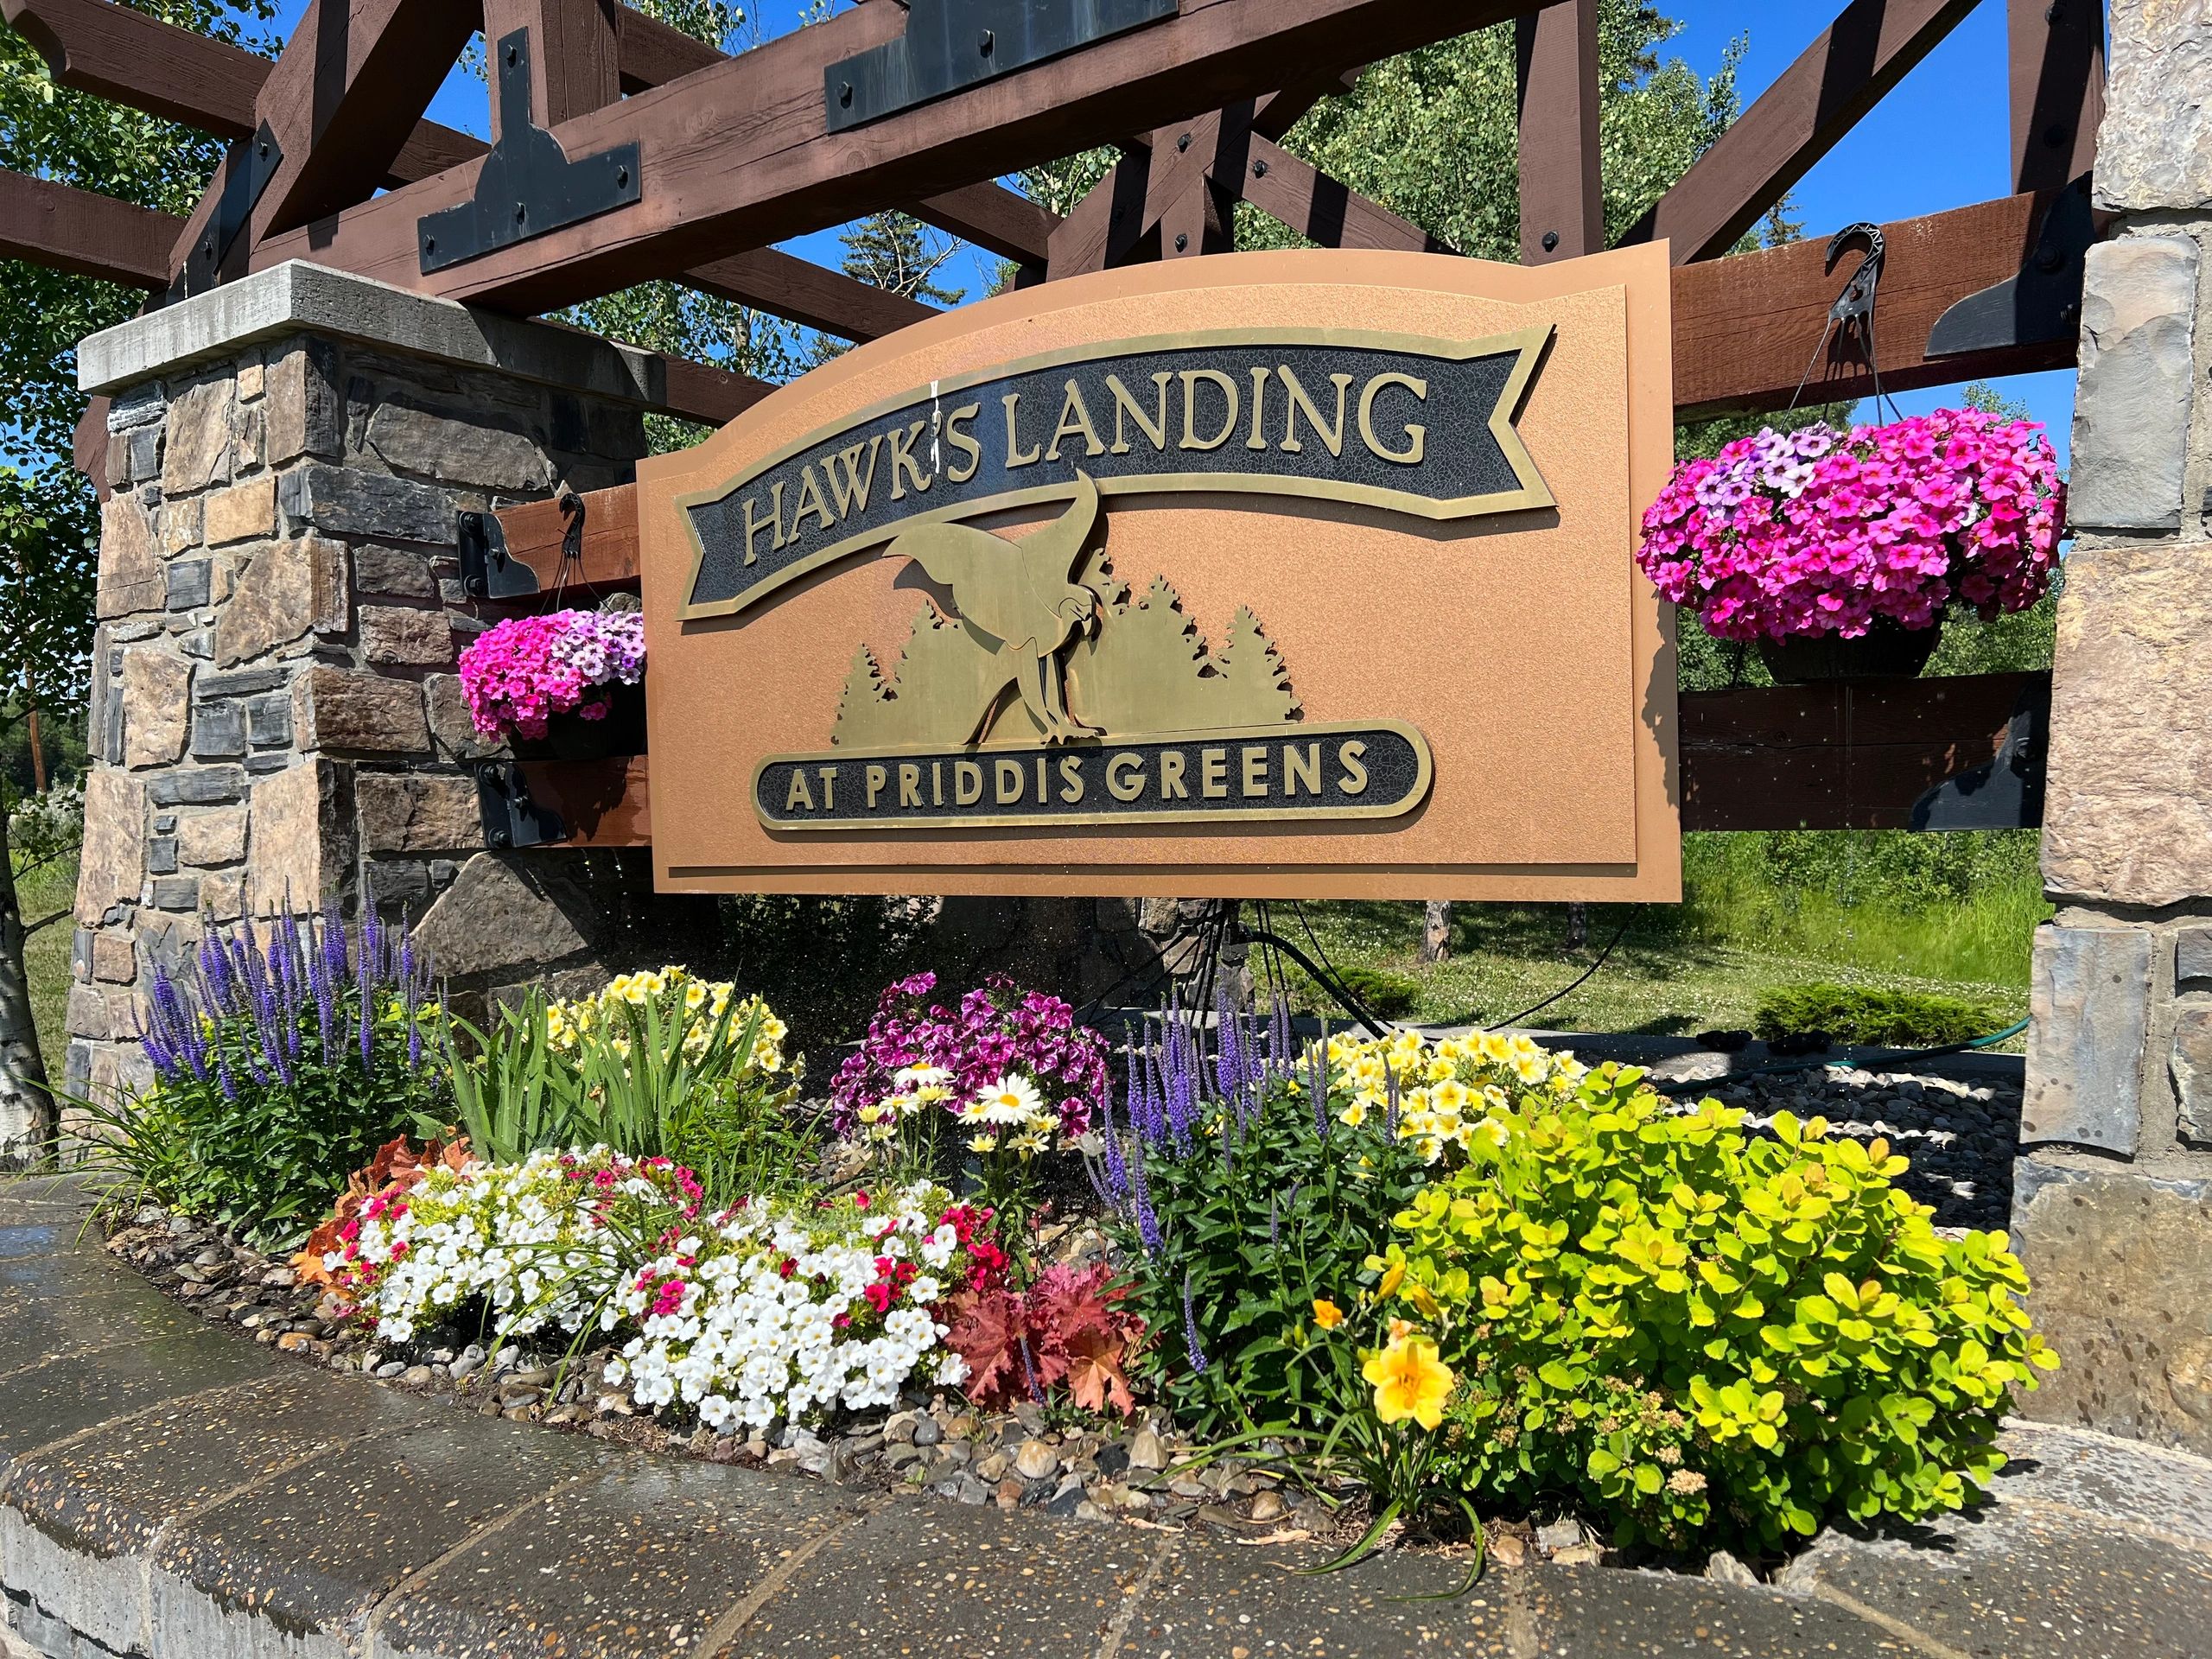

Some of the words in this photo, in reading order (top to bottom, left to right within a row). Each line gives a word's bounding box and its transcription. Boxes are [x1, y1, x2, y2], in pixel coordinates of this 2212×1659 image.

[743, 402, 981, 566] HAWK'S
[1001, 365, 1427, 467] LANDING
[785, 767, 837, 810] AT
[866, 756, 1084, 808] PRIDDIS
[1106, 741, 1368, 801] GREENS
